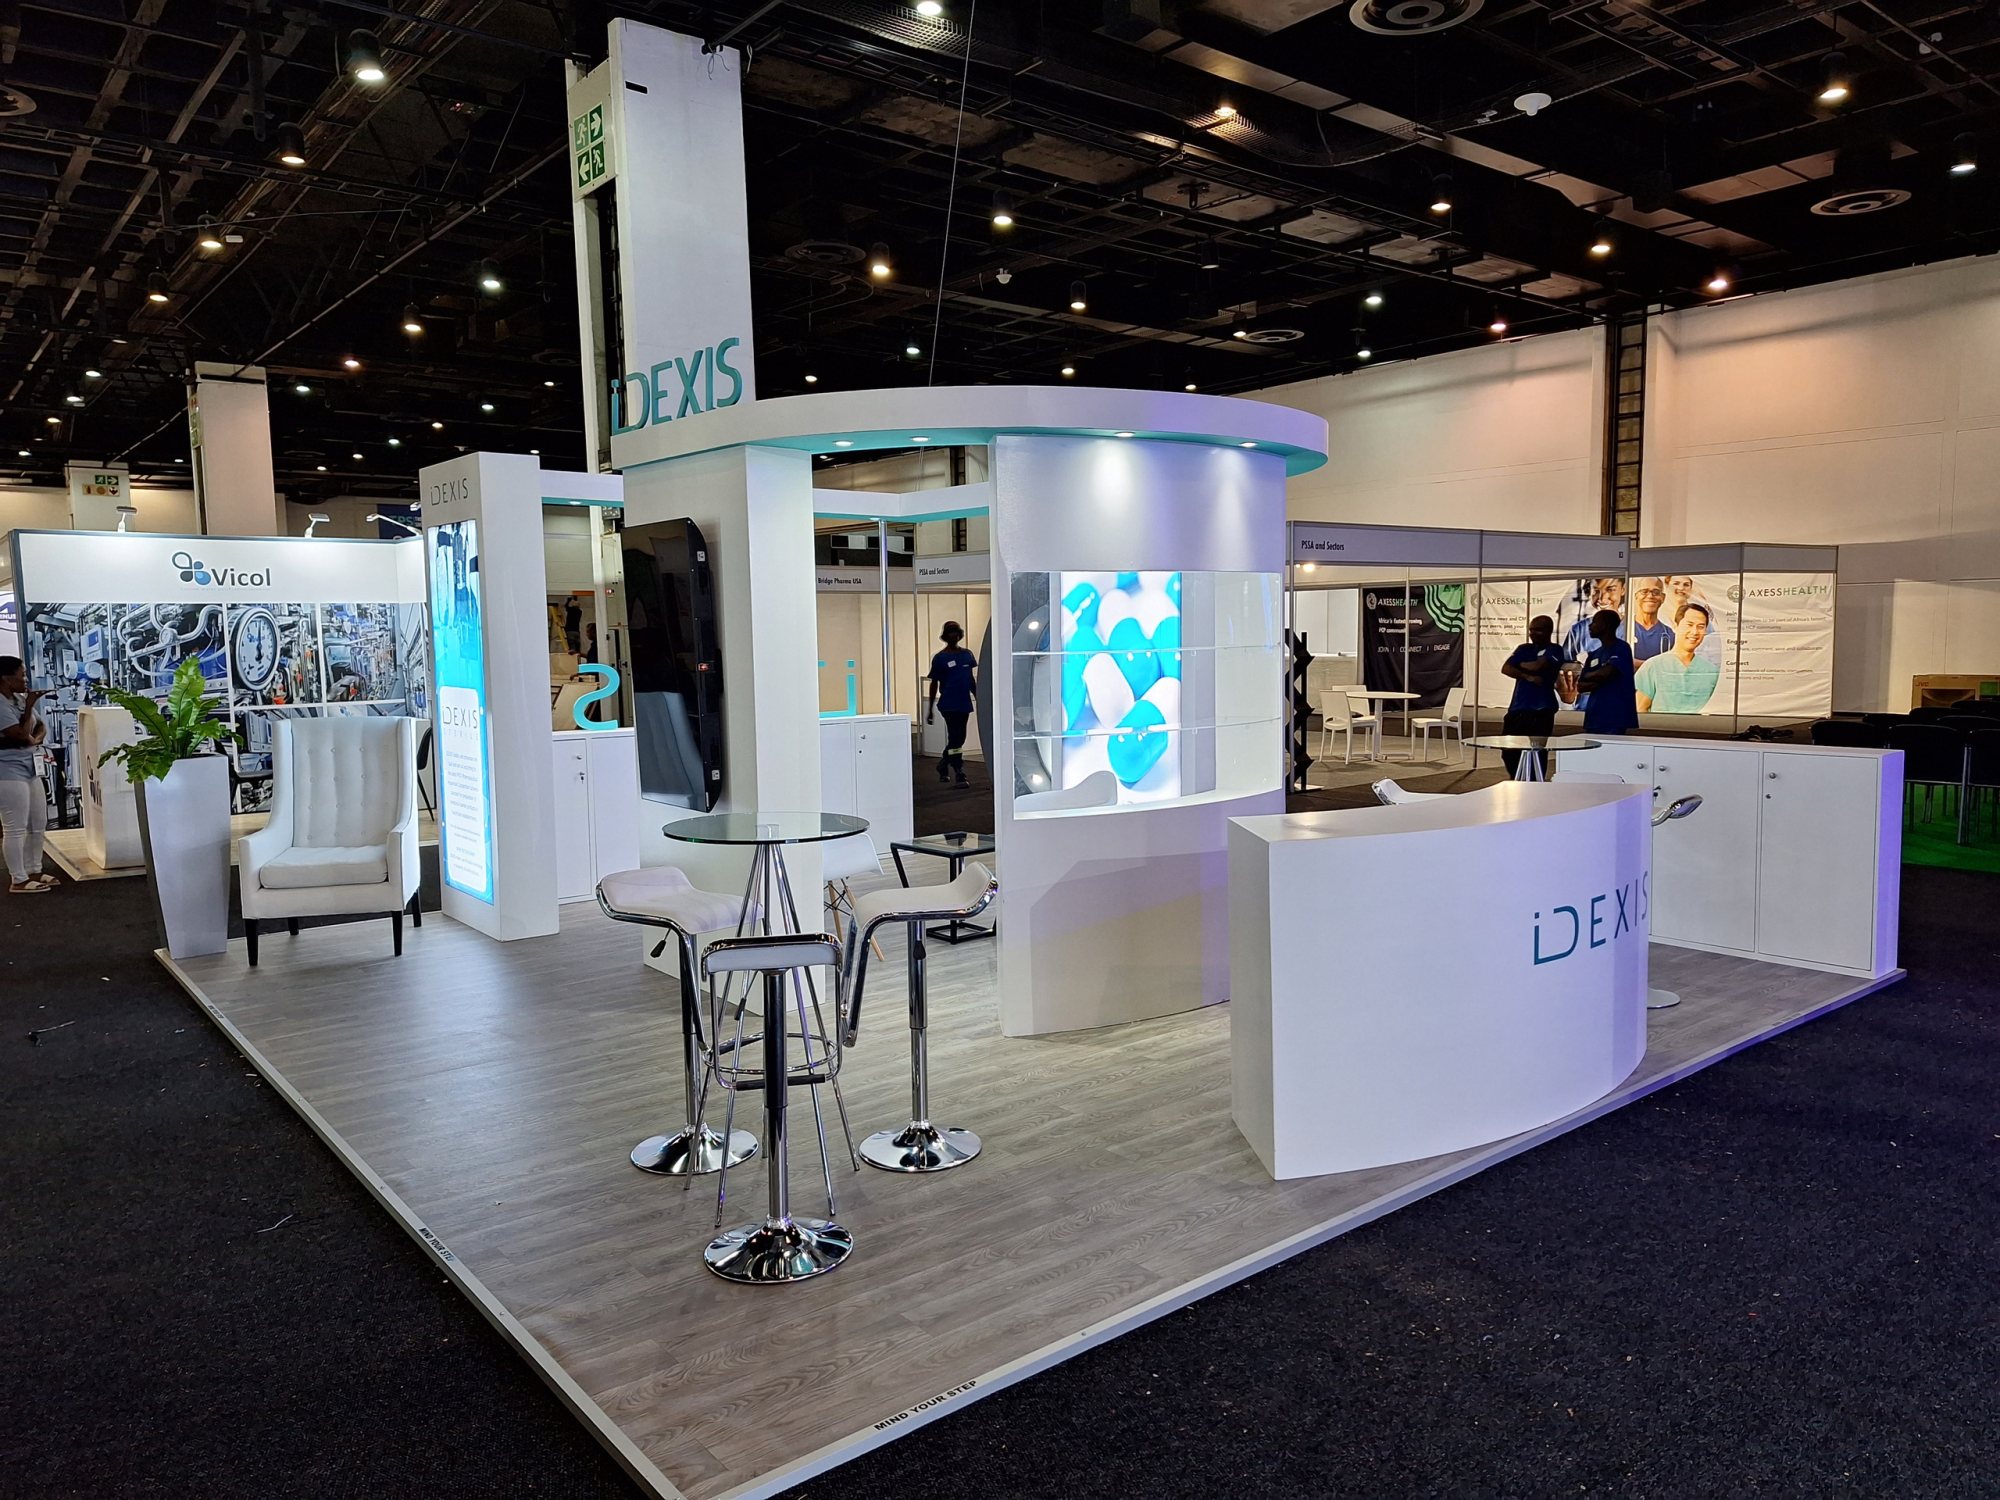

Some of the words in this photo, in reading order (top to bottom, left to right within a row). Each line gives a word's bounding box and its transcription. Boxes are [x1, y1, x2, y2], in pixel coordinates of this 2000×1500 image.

[611, 337, 742, 436] iDEXIS
[430, 478, 469, 506] iDEXIS
[1301, 540, 1314, 550] PSSA
[1315, 541, 1326, 550] and
[1326, 541, 1345, 551] Sectors
[211, 568, 271, 586] Vicol
[817, 577, 834, 586] Bridge
[1748, 585, 1828, 598] AXESSHEALTH
[1533, 870, 1648, 966] iDEXIS
[873, 1411, 909, 1431] MIND
[910, 1395, 947, 1414] YOUR
[946, 1380, 977, 1398] STEP
